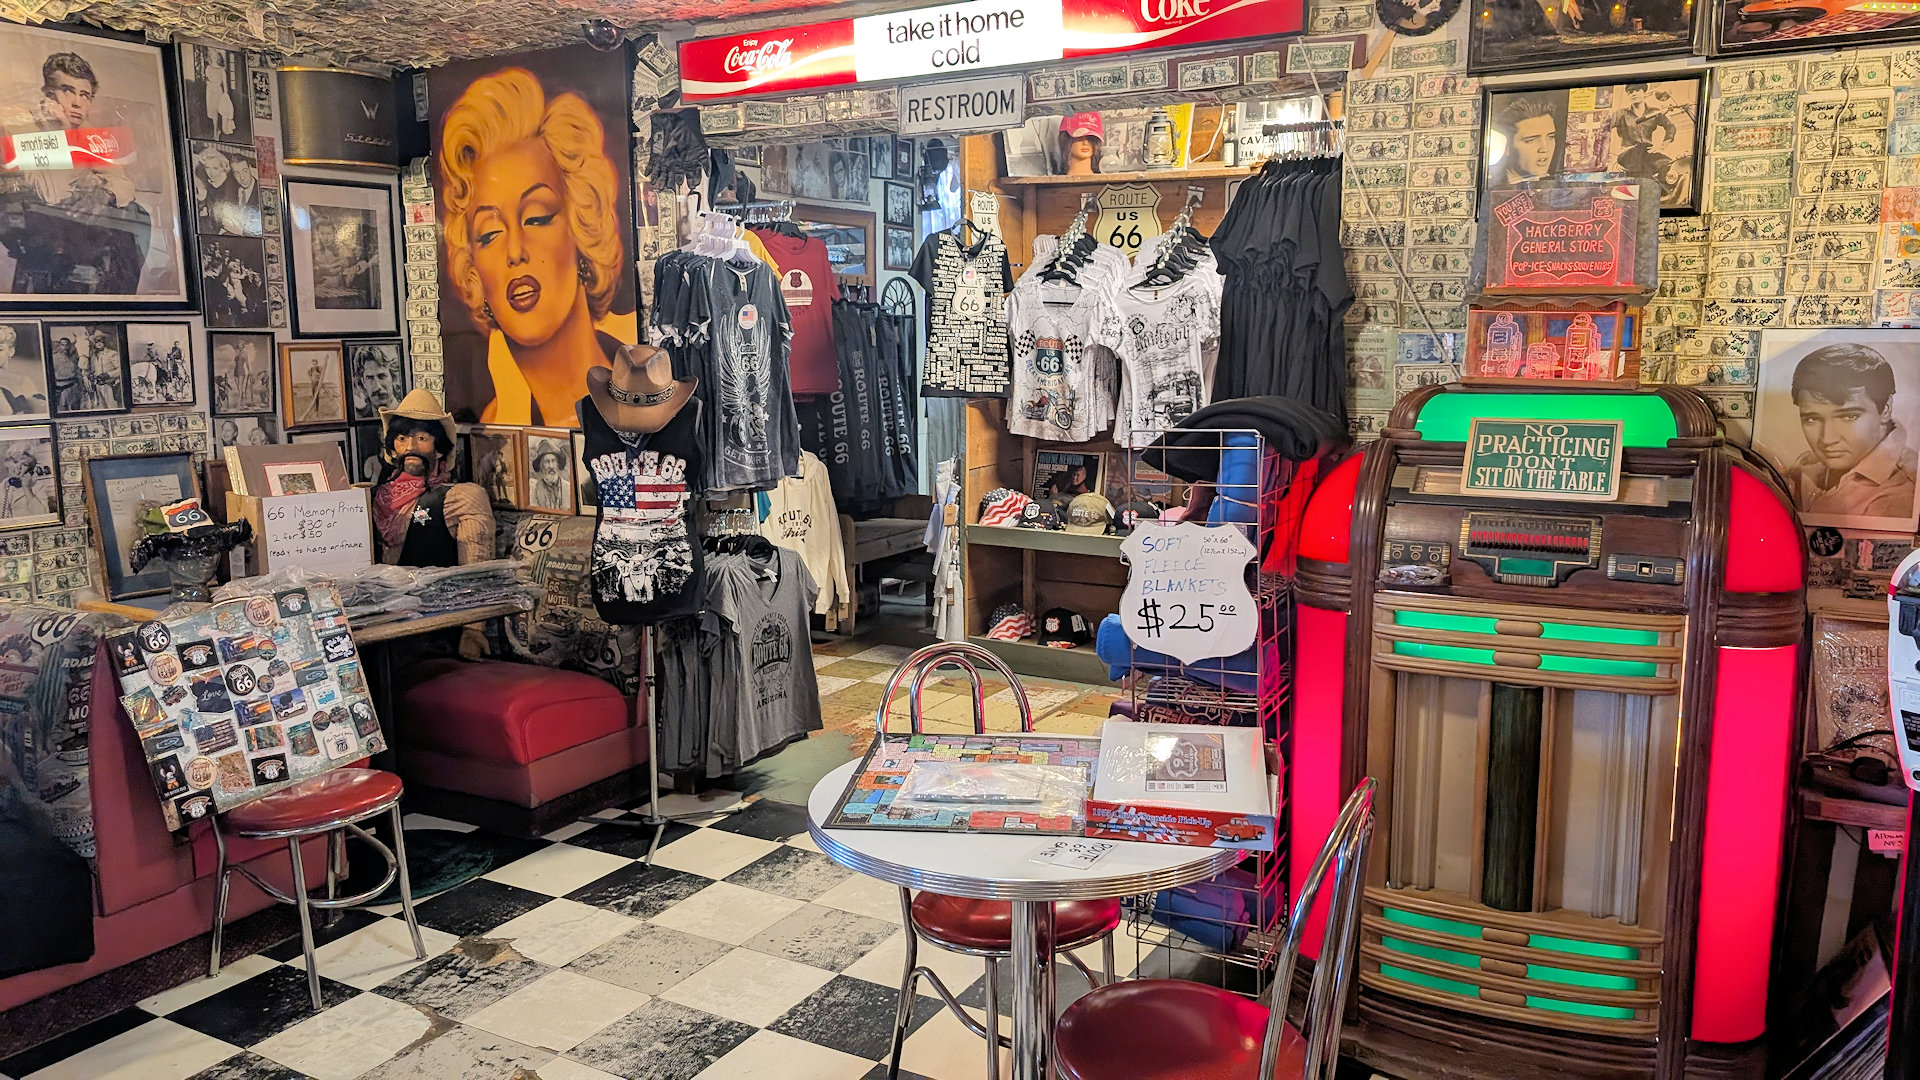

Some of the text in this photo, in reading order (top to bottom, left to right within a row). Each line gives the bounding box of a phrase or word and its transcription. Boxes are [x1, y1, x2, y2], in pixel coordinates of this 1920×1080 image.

[1140, 0, 1210, 23] Coke
[887, 9, 1025, 44] take it home
[743, 39, 758, 48] Enjoy
[723, 38, 795, 74] Coca-Cola
[932, 39, 981, 68] cold
[908, 89, 1016, 123] RESTROOM
[977, 200, 994, 211] ROUTE
[1108, 193, 1148, 206] ROUTE
[981, 217, 992, 225] US
[1116, 210, 1139, 222] US
[1109, 224, 1143, 249] 66
[1525, 223, 1603, 239] HACKBERRY
[1520, 239, 1604, 254] GENERAL STORE
[959, 296, 980, 312] 66
[1039, 339, 1064, 350] ROUTE
[741, 354, 759, 373] 66
[1040, 358, 1058, 373] 66
[853, 367, 871, 450] ROUTE 66
[1524, 424, 1569, 437] NO
[834, 442, 850, 465] 66
[1476, 434, 1611, 458] PRACTICING
[660, 454, 687, 483] 66
[1506, 455, 1575, 471] DON'T
[1475, 467, 1606, 492] SIT ON THE TABLE
[175, 510, 201, 524] 66
[267, 501, 364, 520] 66 Memory Prints
[298, 519, 323, 531] $30
[272, 534, 280, 542] 2
[283, 533, 298, 541] for
[524, 523, 553, 547] 66
[1142, 534, 1189, 553] SOFT
[269, 549, 291, 558] ready
[295, 545, 303, 554] to
[306, 545, 327, 554] hang
[339, 540, 364, 549] frame
[1143, 557, 1206, 574] FLEECE
[1141, 579, 1228, 596] BLANKETS
[547, 594, 571, 606] MOTEL
[142, 622, 168, 650] ROUTE 66
[753, 639, 790, 667] ROUTE 66
[236, 676, 253, 692] 66
[756, 692, 788, 710] ARIZONA
[1177, 816, 1212, 829] Pick-Up
[1040, 841, 1068, 858] GAME
[1069, 843, 1086, 853] 66
[1078, 842, 1113, 863] ROUTE
